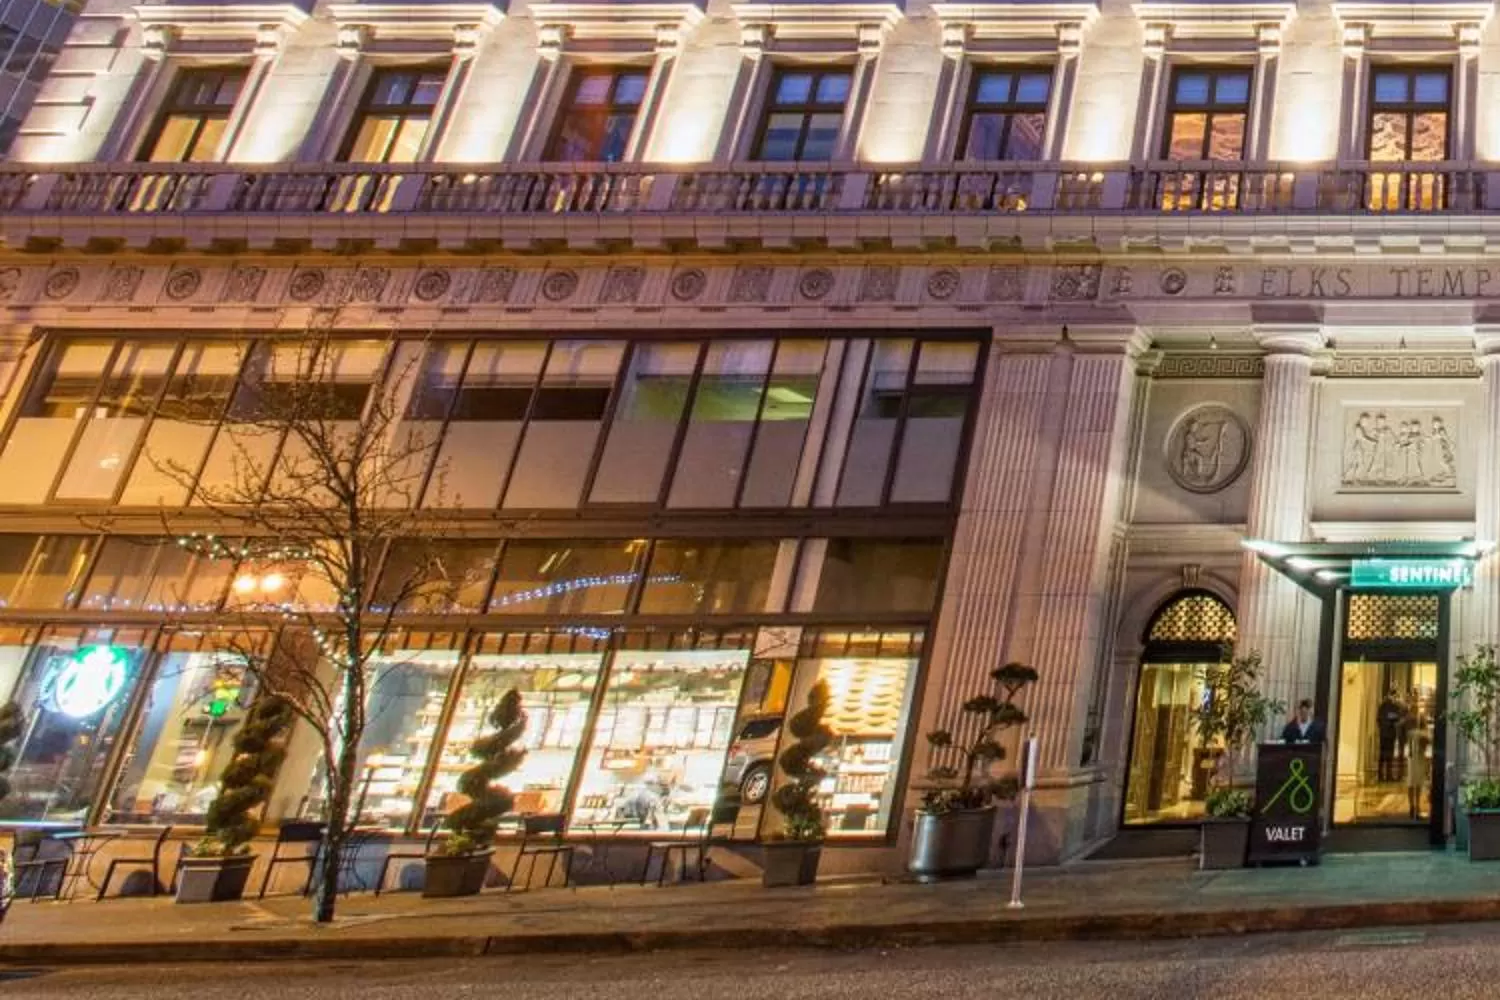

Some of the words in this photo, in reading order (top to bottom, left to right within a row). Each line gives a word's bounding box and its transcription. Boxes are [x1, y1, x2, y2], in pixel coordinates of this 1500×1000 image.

[1259, 267, 1353, 297] ELKS
[1389, 565, 1471, 583] SENTINEL
[1265, 826, 1305, 841] VALET
